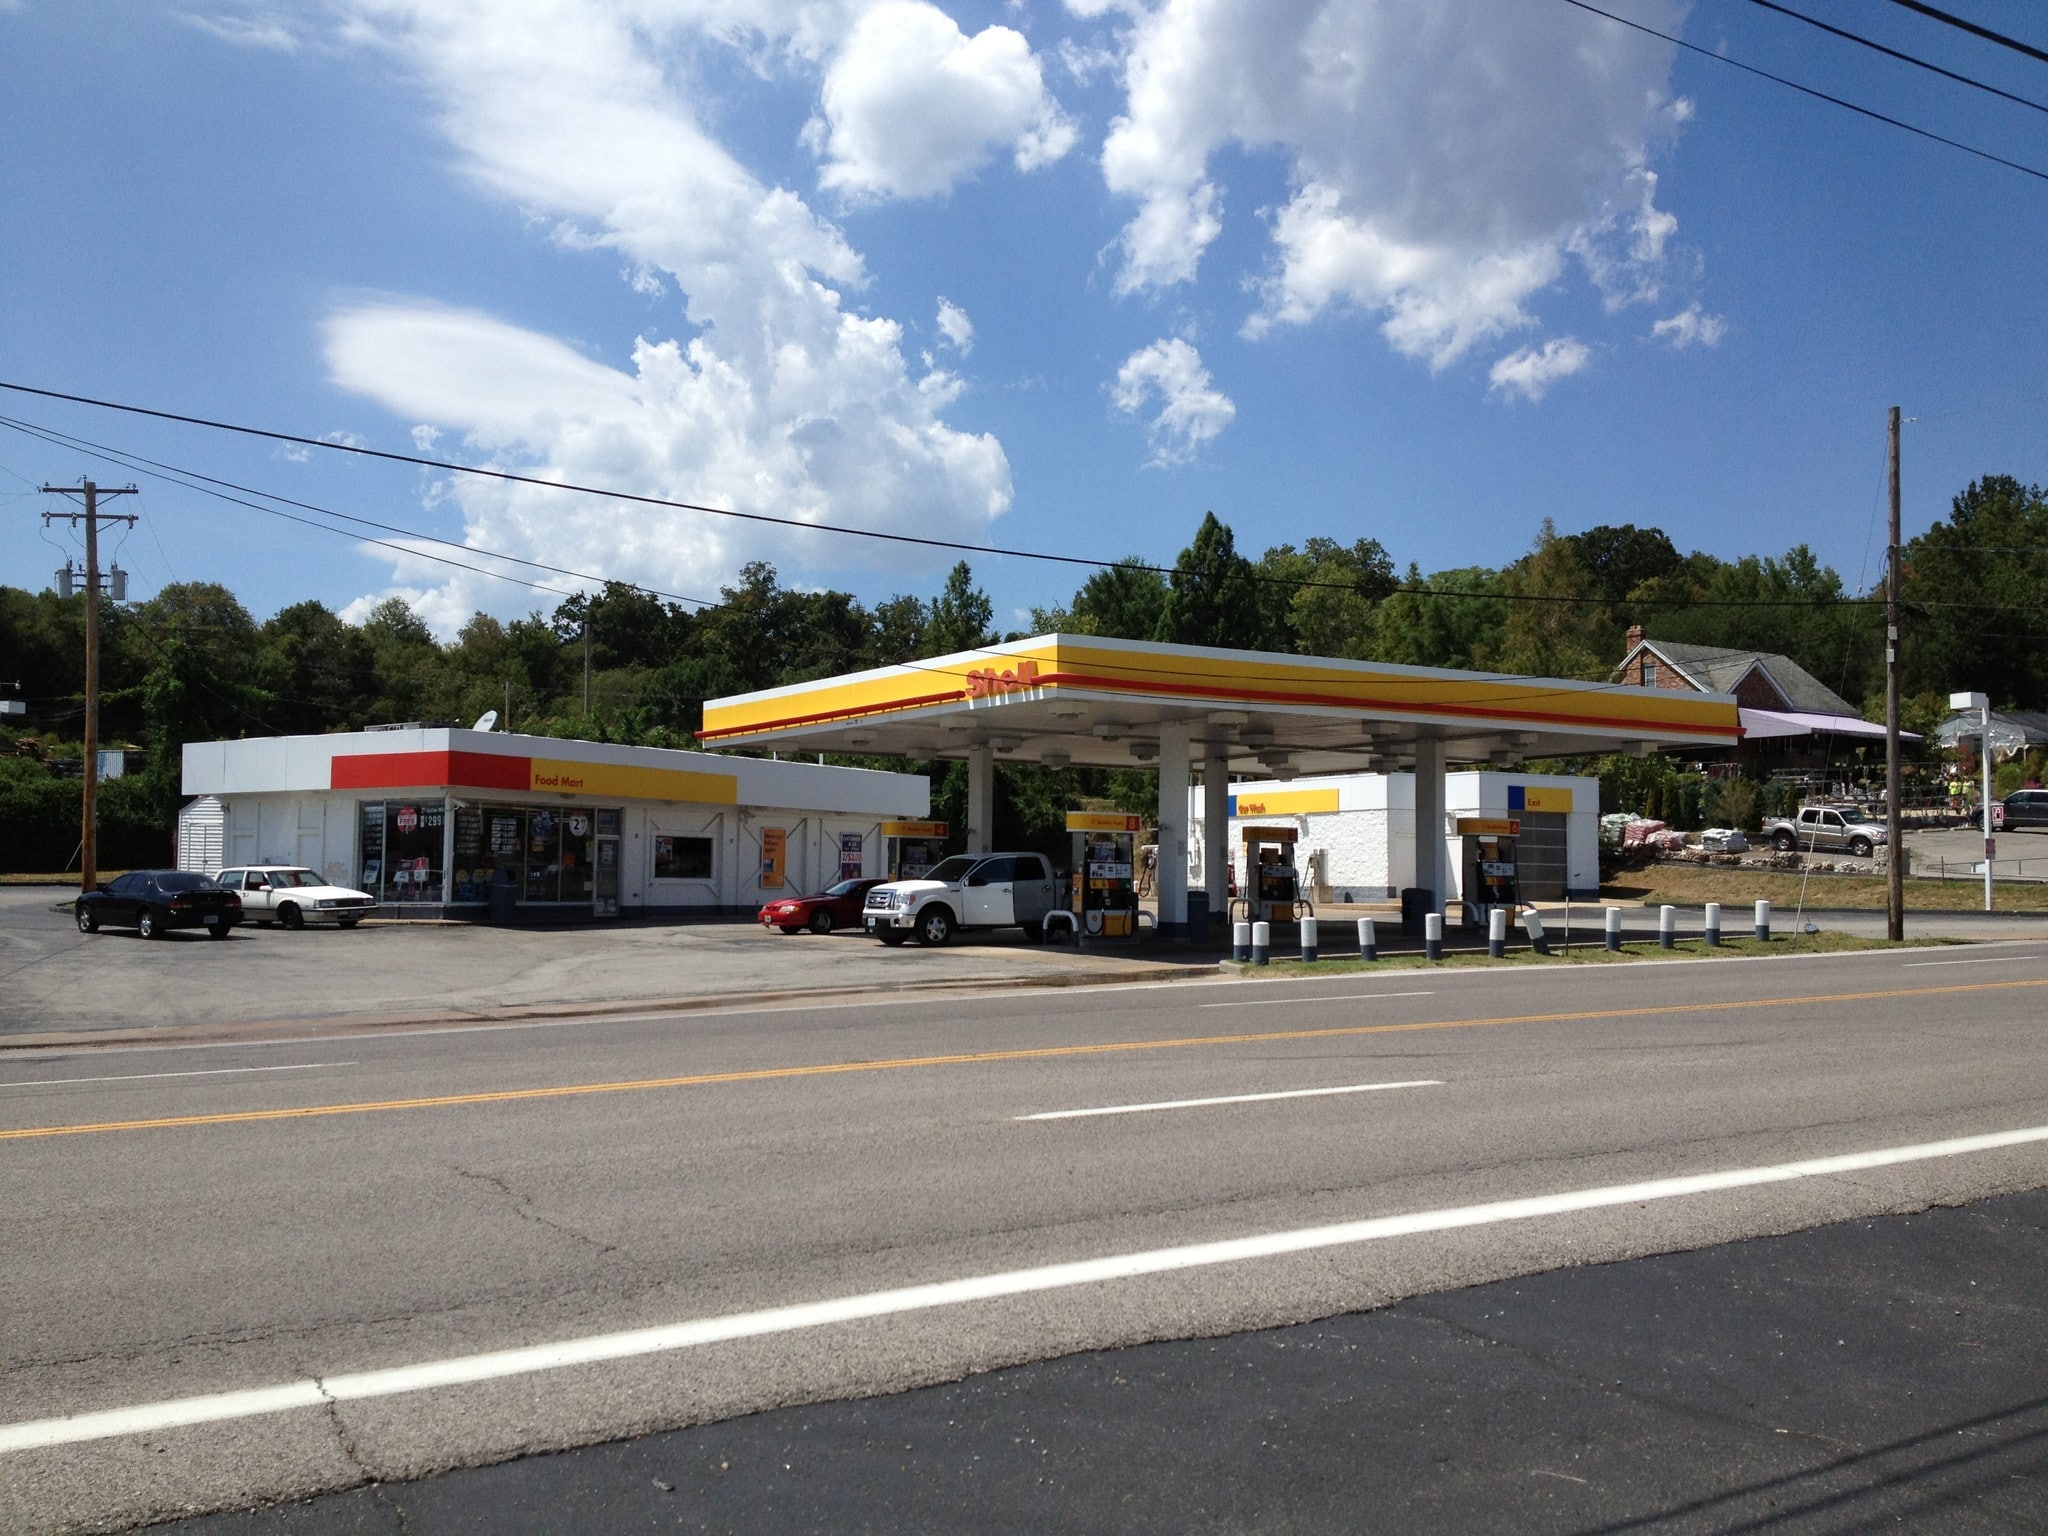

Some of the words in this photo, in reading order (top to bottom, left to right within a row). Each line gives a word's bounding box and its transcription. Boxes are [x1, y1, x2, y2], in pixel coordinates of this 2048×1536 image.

[965, 661, 1038, 697] Shell
[535, 774, 558, 787] Food
[561, 776, 584, 788] Mart
[1527, 798, 1541, 807] Exit
[1129, 817, 1136, 829] 8
